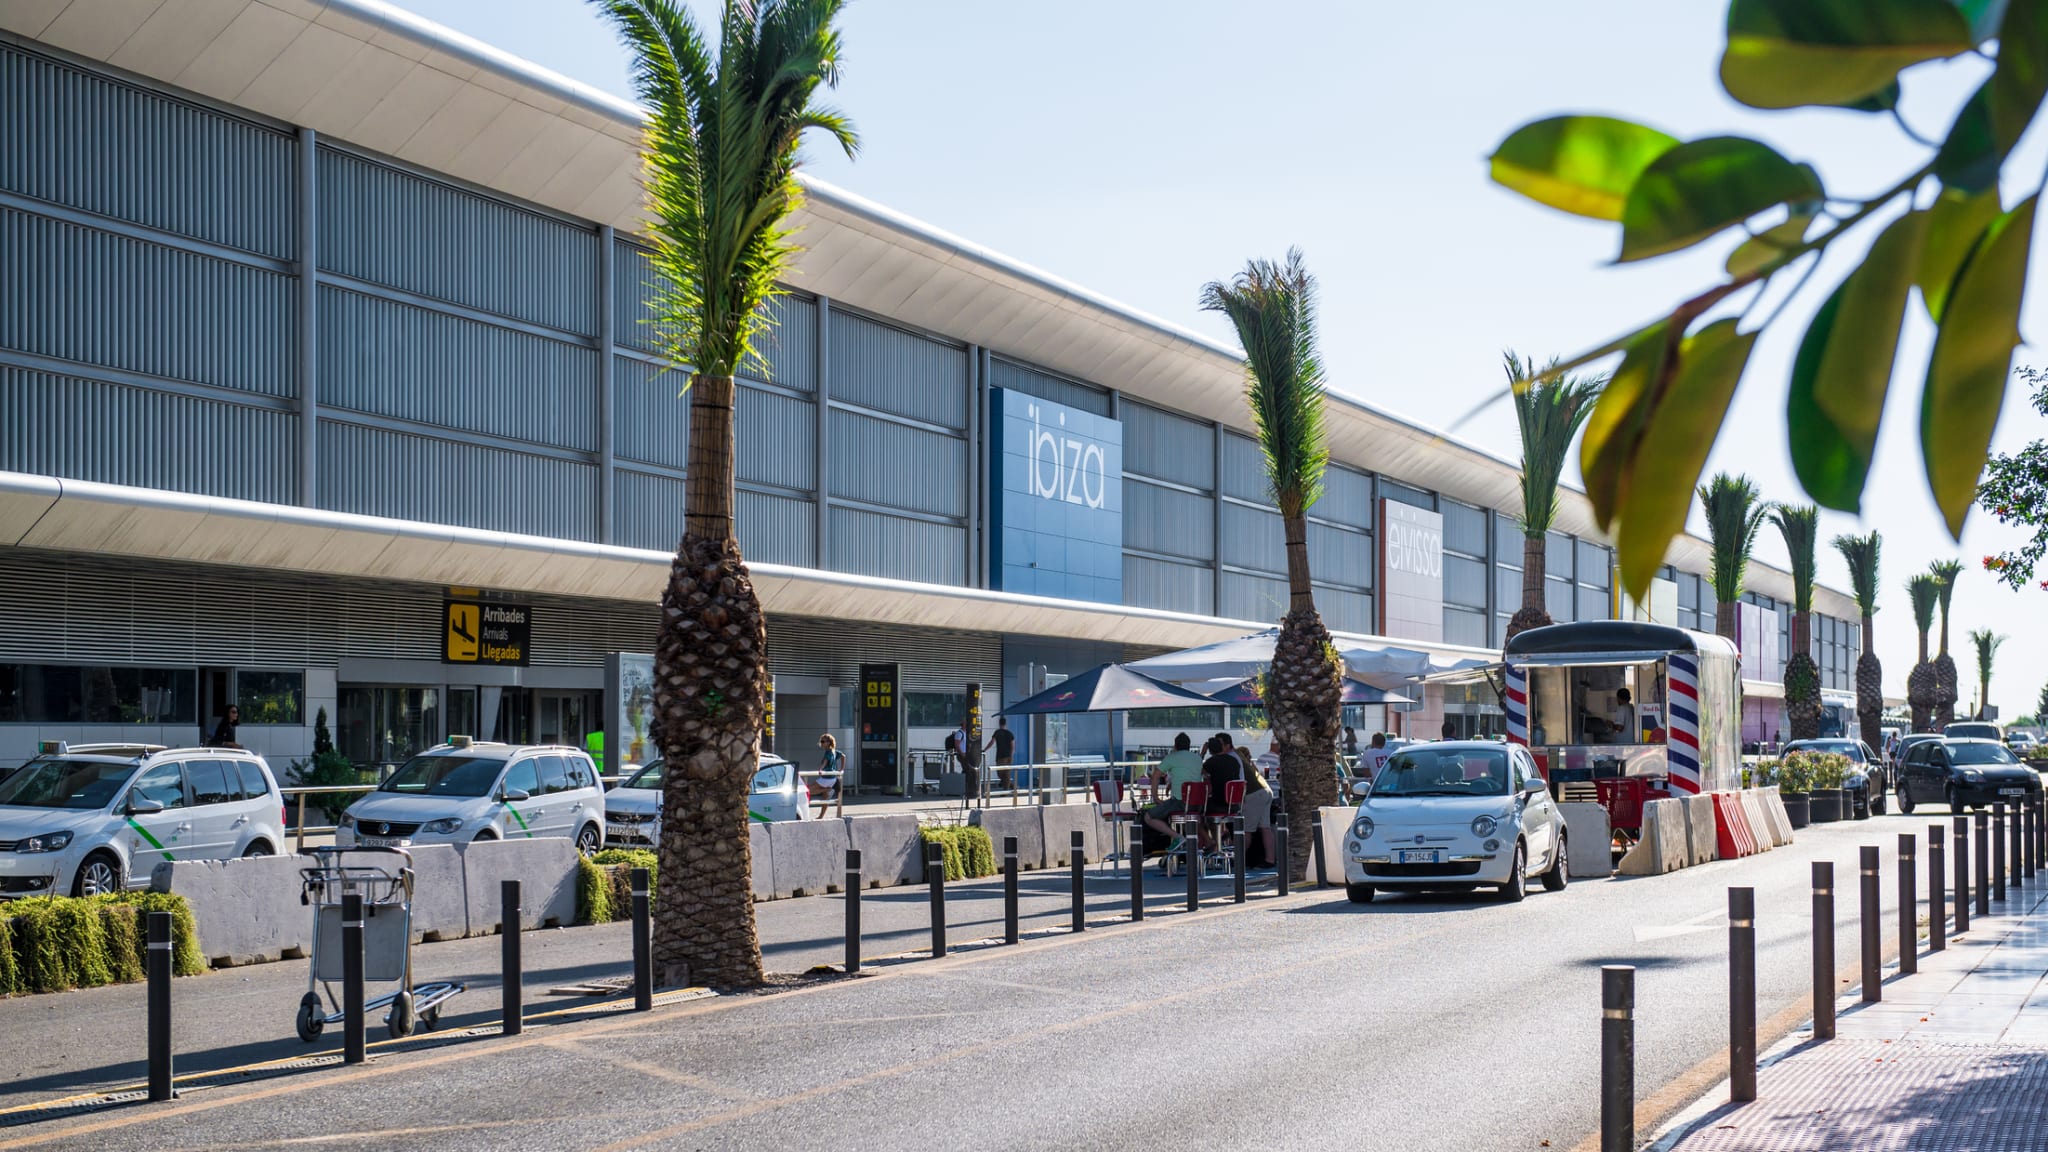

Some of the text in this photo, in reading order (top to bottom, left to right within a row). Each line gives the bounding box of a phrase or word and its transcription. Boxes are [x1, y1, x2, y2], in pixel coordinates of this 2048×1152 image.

[1028, 403, 1104, 509] ibiza
[1388, 508, 1441, 578] eivissa
[483, 606, 525, 623] Arribades
[482, 626, 509, 641] Arrivals
[482, 643, 521, 662] Llegadas
